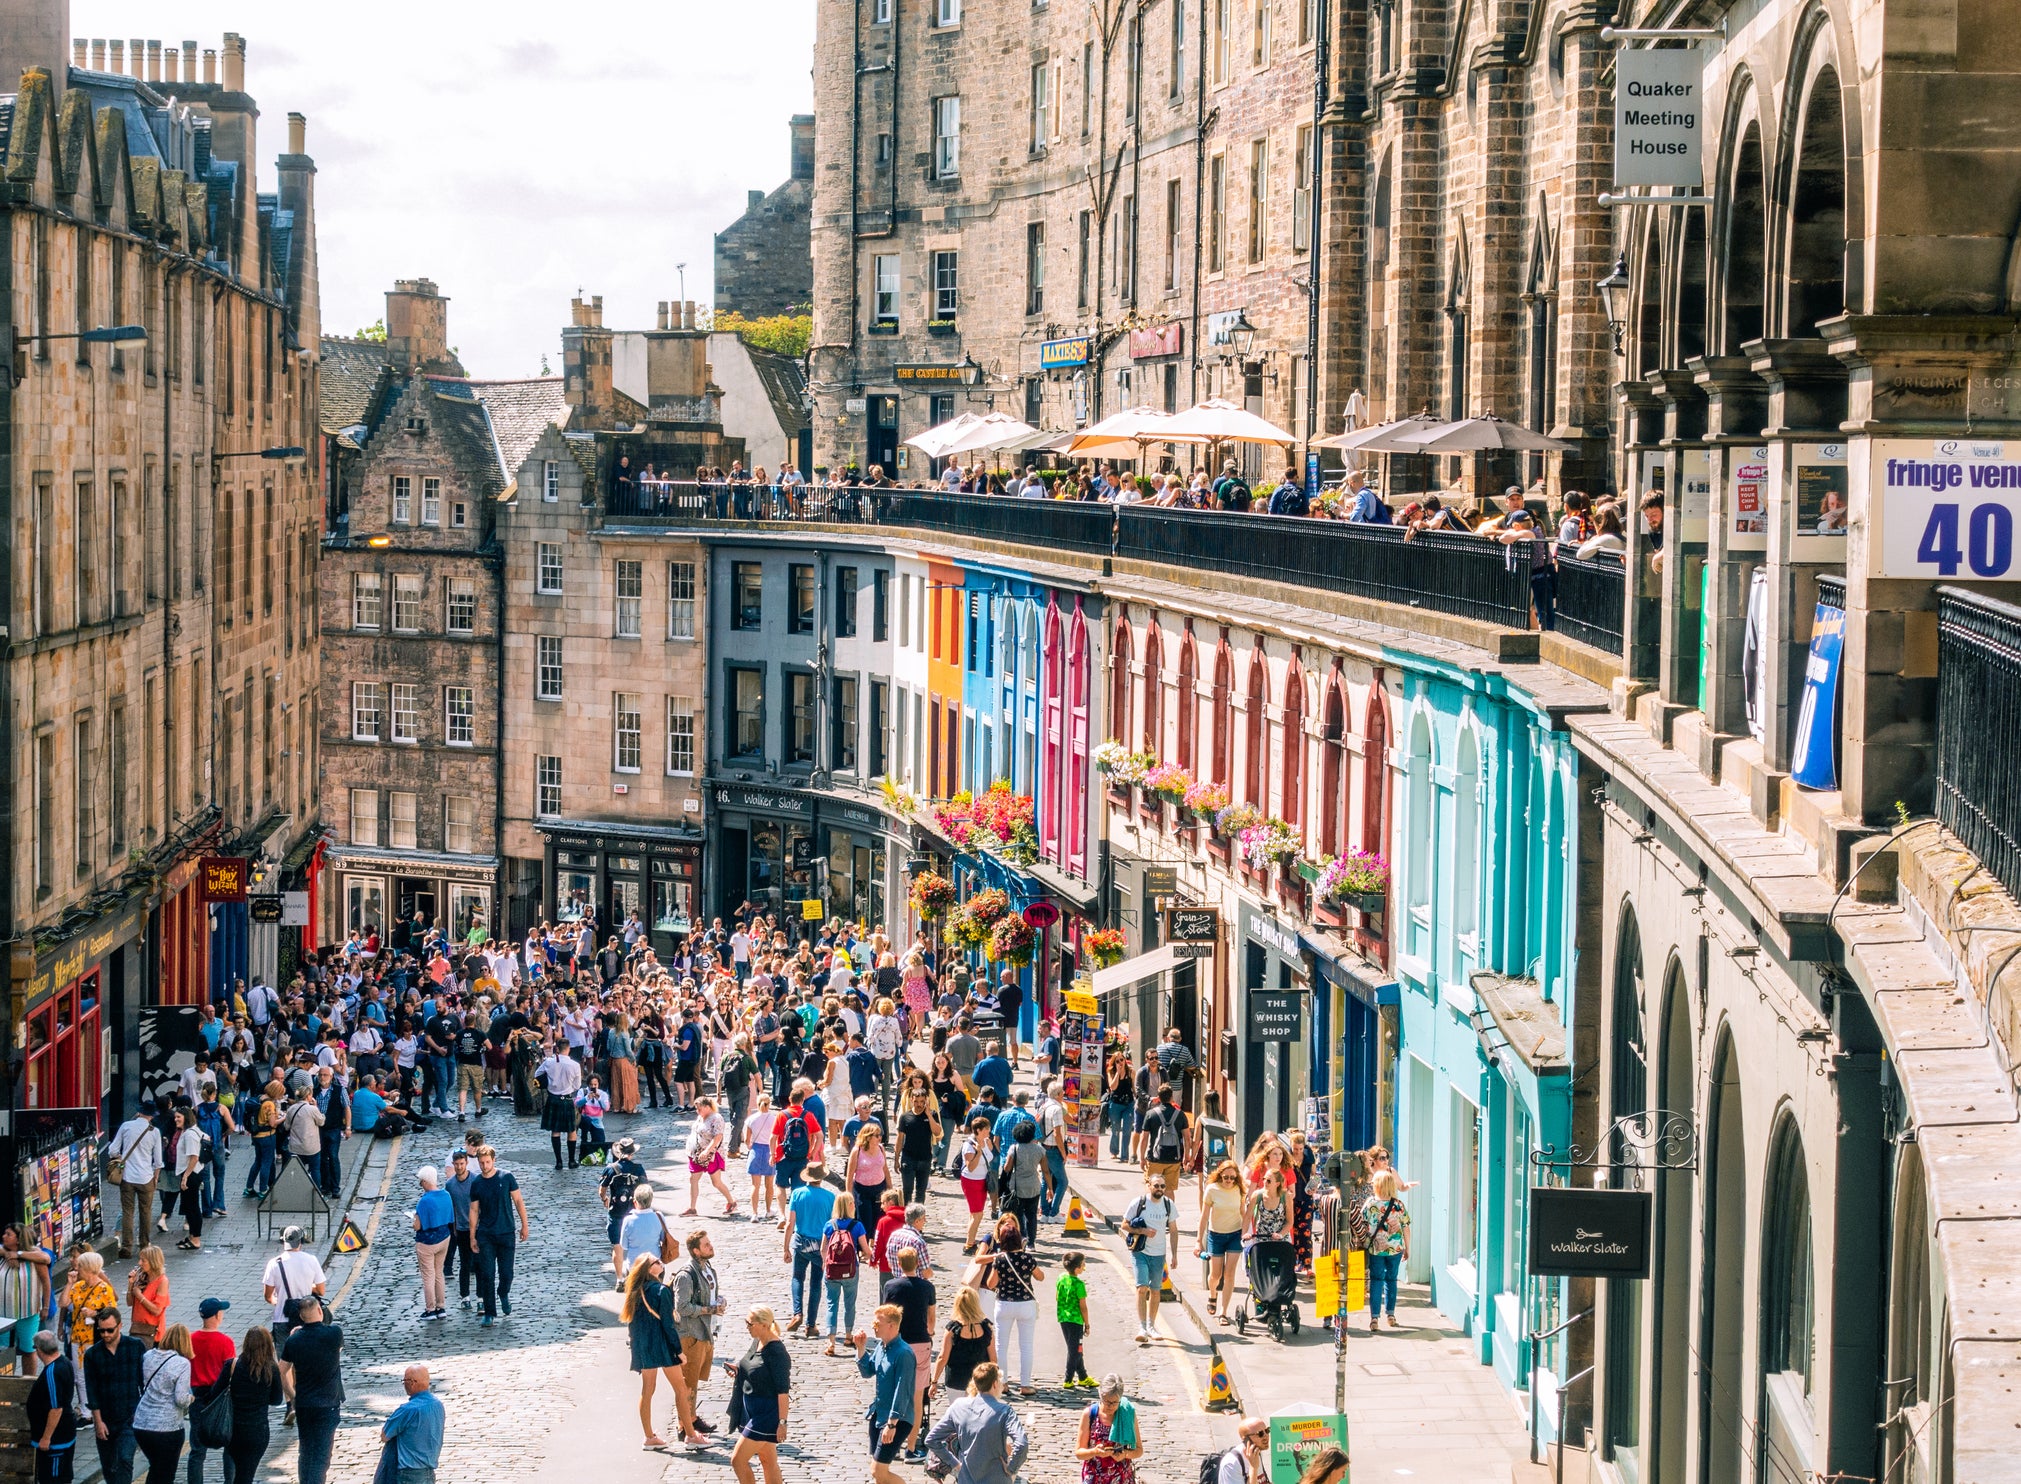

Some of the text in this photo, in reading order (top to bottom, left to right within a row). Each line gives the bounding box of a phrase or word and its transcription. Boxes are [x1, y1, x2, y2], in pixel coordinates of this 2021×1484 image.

[1628, 81, 1693, 97] Quaker
[1625, 110, 1695, 129] Meeting
[1631, 139, 1688, 154] House
[897, 368, 914, 378] THE
[916, 368, 947, 378] CASTLE
[1887, 459, 2021, 492] fringe ven
[1917, 503, 2013, 577] 40
[744, 794, 773, 807] Walker
[778, 797, 803, 810] Slater
[560, 837, 588, 845] CLARKSONS
[220, 869, 237, 881] Boy
[335, 860, 347, 869] 89
[482, 872, 495, 881] 89
[208, 880, 238, 891] Wizard
[1174, 911, 1198, 928] Grain
[1183, 924, 1211, 939] Store
[1250, 914, 1298, 960] THE WHISKY SHOP
[1174, 946, 1211, 957] RESTAURANT
[1266, 1000, 1287, 1008] THE
[1254, 1011, 1299, 1023] WHISKY
[1262, 1028, 1291, 1036] SHOP
[1292, 1422, 1321, 1431] MURDER
[1303, 1430, 1329, 1439] MERCY
[1276, 1441, 1342, 1453] DROWNING
